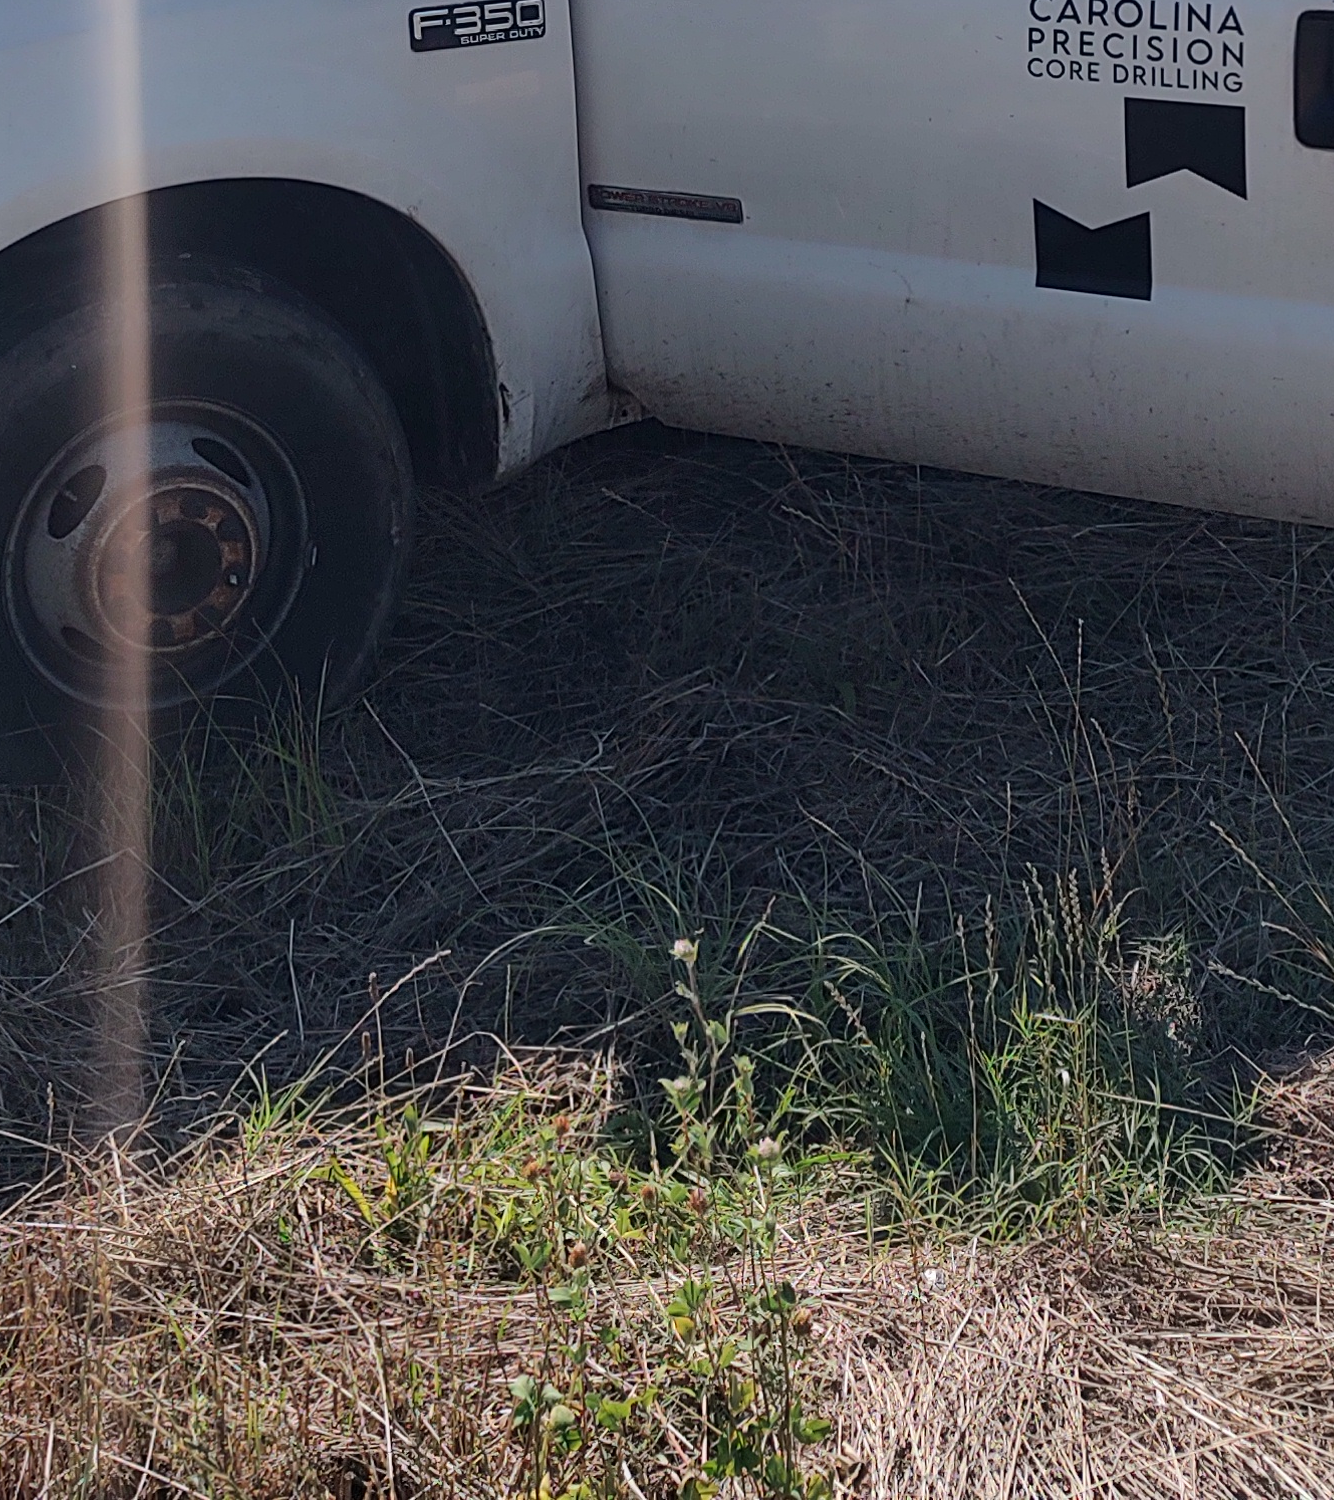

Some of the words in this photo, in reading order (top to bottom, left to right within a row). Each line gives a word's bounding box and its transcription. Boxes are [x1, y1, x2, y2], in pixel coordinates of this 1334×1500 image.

[460, 32, 506, 45] SUPER
[509, 26, 544, 39] DUTY
[1028, 27, 1244, 68] PRECISION
[1027, 57, 1100, 82] CORE
[1113, 63, 1243, 92] DRILLING
